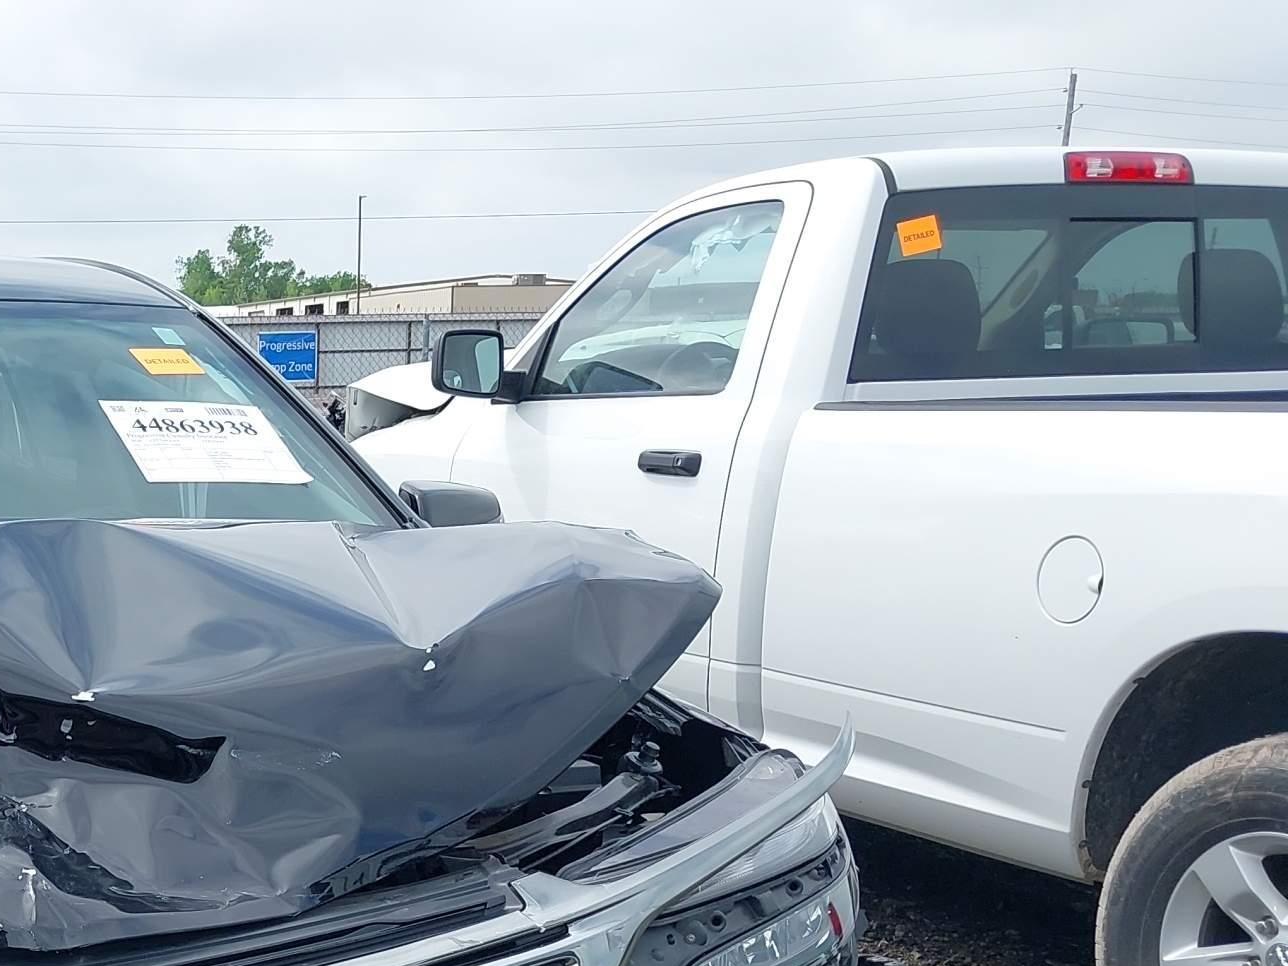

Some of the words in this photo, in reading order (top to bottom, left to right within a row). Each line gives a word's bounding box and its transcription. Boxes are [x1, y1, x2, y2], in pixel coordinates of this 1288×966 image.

[903, 230, 935, 243] DETAILED
[259, 339, 315, 352] Progressive
[288, 362, 313, 372] Zone
[132, 418, 259, 437] 44863938
